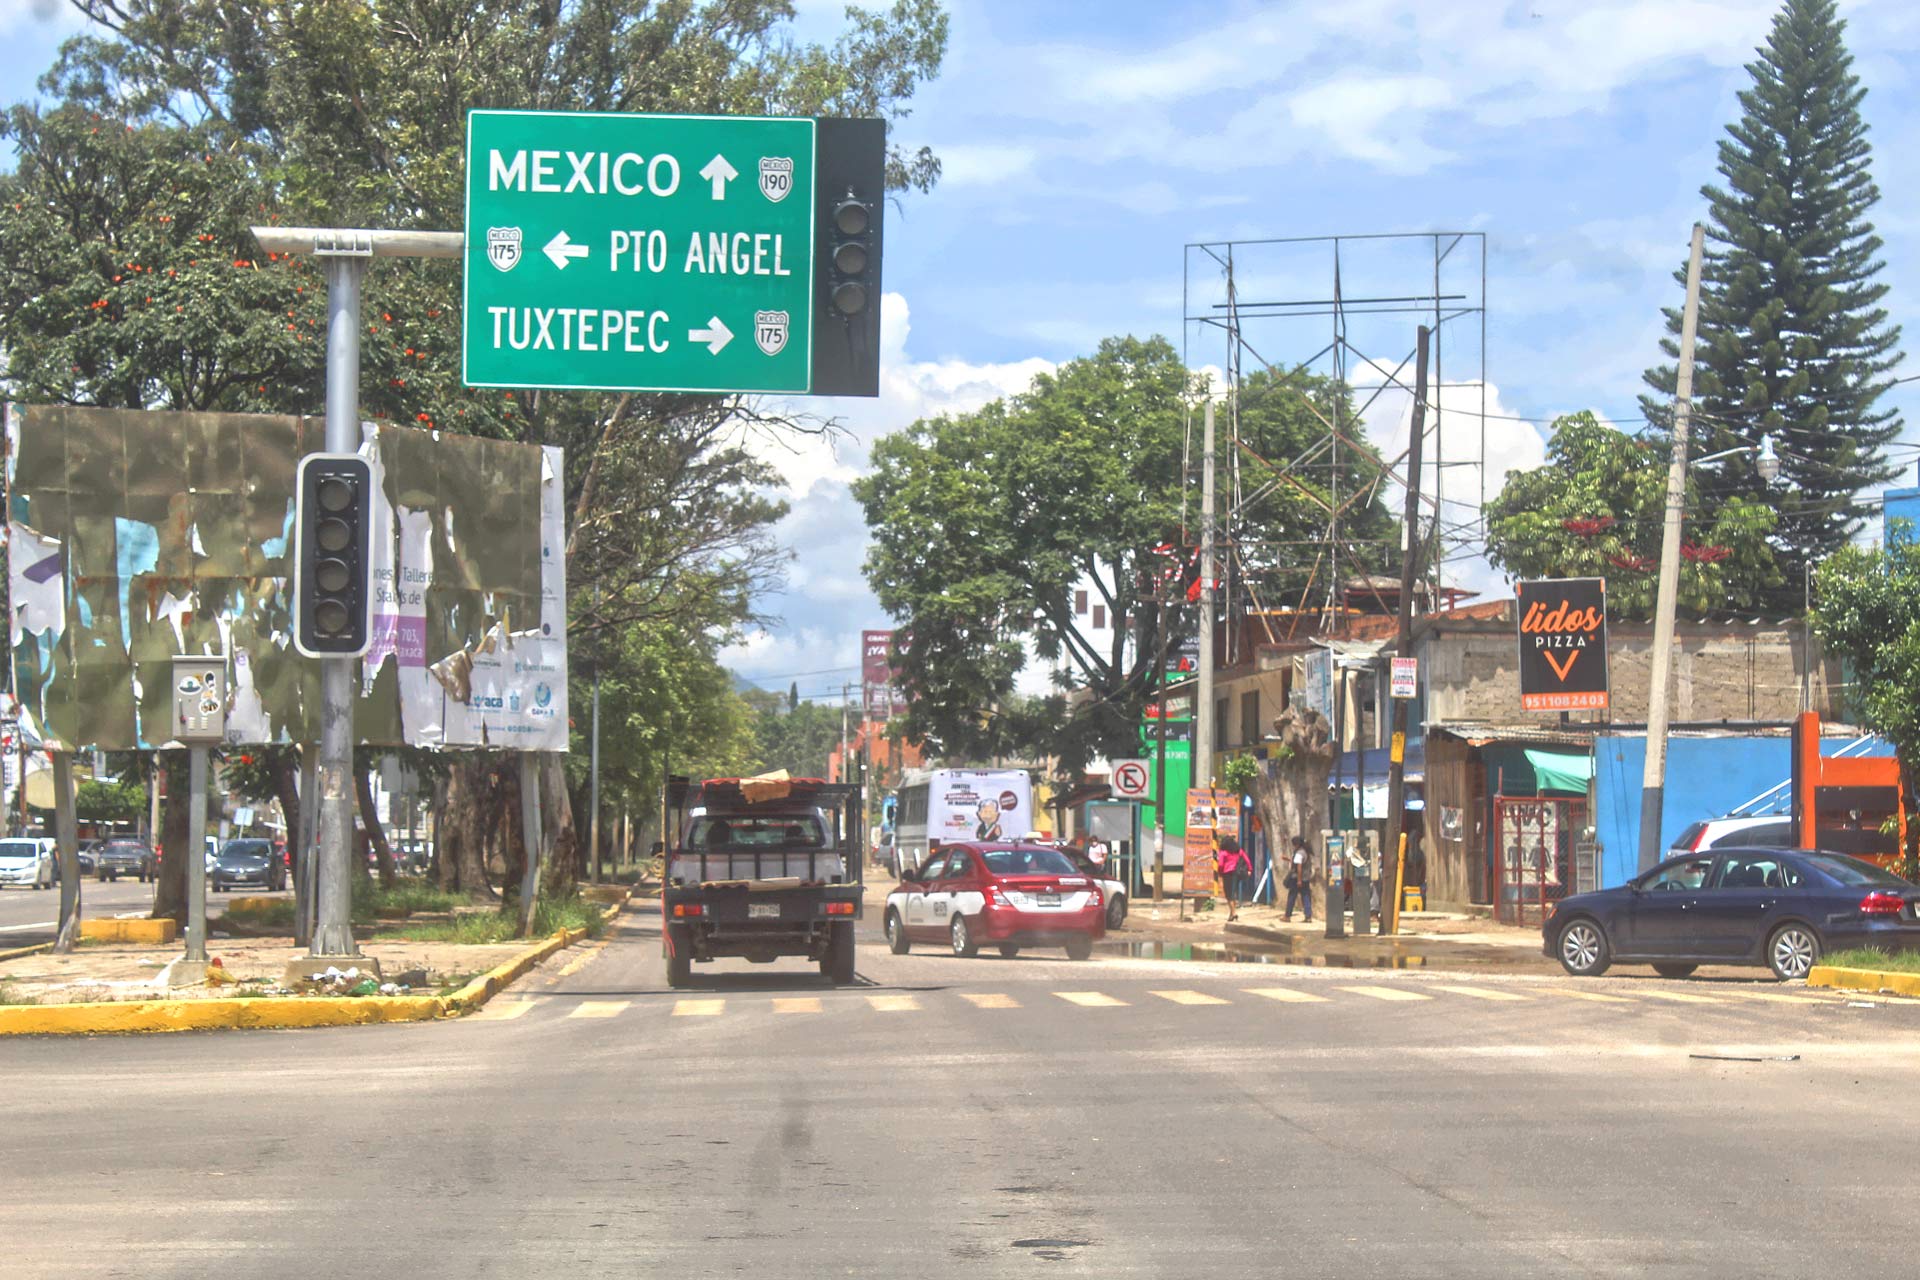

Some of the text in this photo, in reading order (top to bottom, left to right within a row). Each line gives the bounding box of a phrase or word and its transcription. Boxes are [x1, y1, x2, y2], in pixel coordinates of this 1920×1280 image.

[763, 161, 789, 169] MEXICO
[488, 150, 681, 197] MEXICO
[764, 174, 788, 191] 190
[494, 244, 516, 260] 175
[610, 230, 791, 276] PTO ANGEL
[758, 315, 785, 323] MEXICO
[488, 306, 670, 353] TUXTEPEC
[761, 328, 783, 344] 175
[376, 587, 421, 605] Stas de
[1521, 600, 1603, 633] lidos
[1535, 636, 1586, 648] PIZZA
[399, 648, 422, 658] axaca
[1178, 657, 1199, 672] AD
[1124, 769, 1138, 788] E
